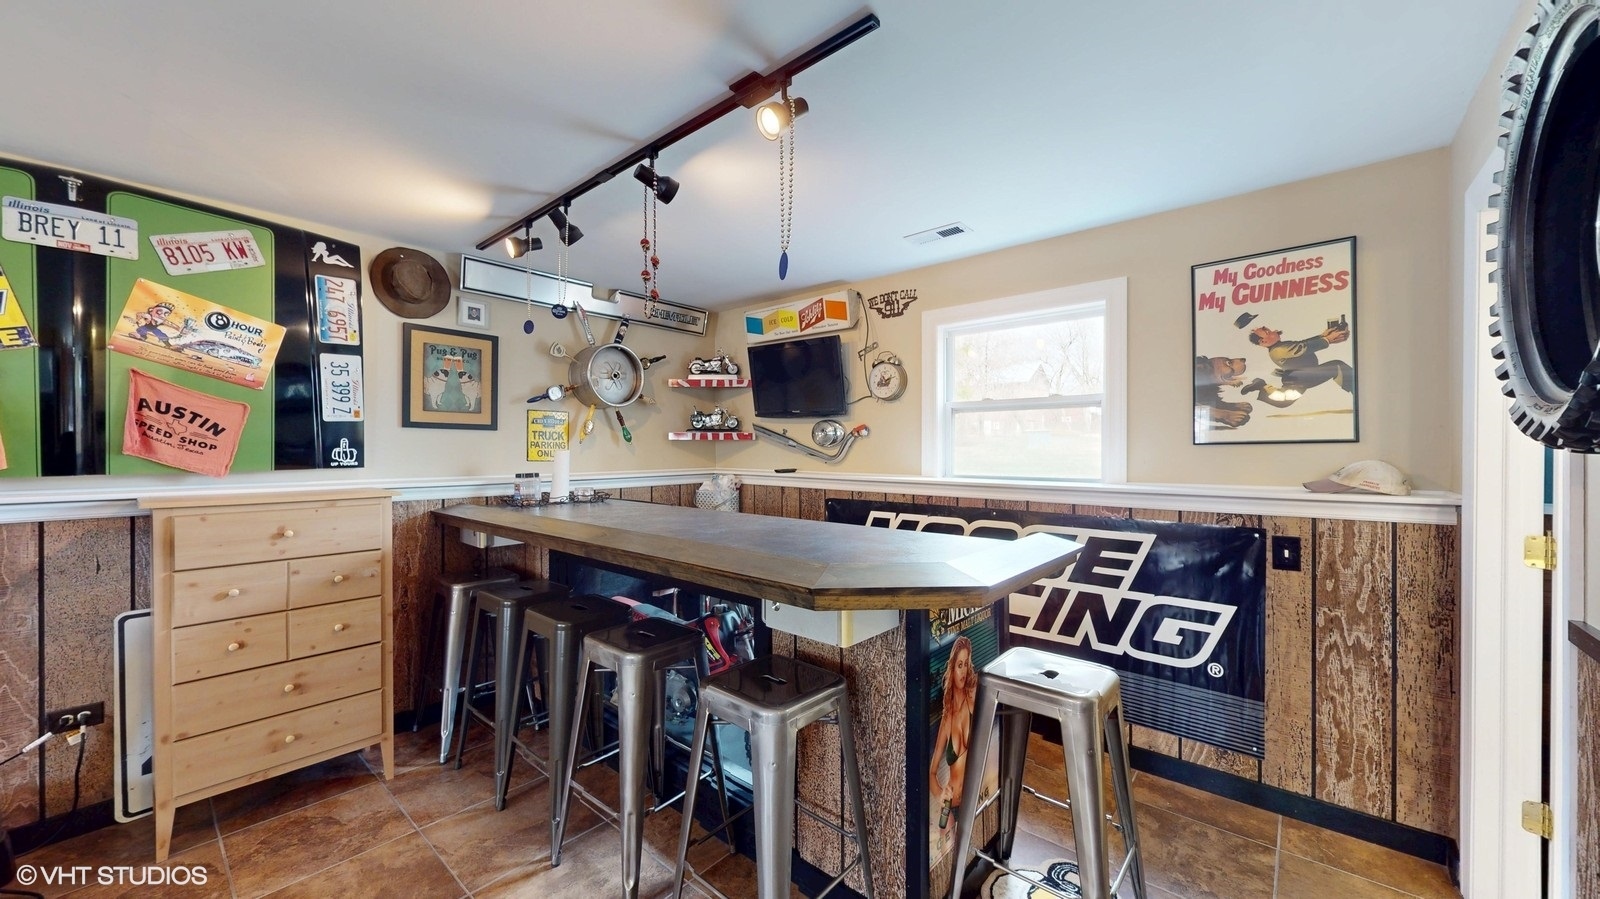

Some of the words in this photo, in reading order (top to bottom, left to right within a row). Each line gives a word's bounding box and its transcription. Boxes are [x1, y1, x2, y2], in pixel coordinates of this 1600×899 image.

[18, 211, 80, 240] BREY
[98, 226, 125, 248] 11
[162, 243, 215, 266] 8105
[222, 240, 249, 260] KW
[1212, 267, 1238, 287] My
[1243, 256, 1324, 281] Goodness
[325, 278, 345, 304] 247
[900, 289, 918, 300] CALL
[1198, 292, 1226, 312] My
[1231, 270, 1350, 306] GUINNESS
[230, 322, 263, 336] HOUR
[327, 310, 348, 342] 6957
[780, 316, 794, 324] COLD
[429, 344, 448, 356] Pug
[460, 348, 478, 360] Pug
[330, 361, 350, 377] 35
[332, 380, 351, 404] 399
[137, 398, 226, 438] AUSTIN
[134, 418, 173, 438] SPEED
[179, 436, 218, 450] SHOP
[530, 441, 566, 450] PARKING
[532, 430, 565, 440] TRUCK
[537, 450, 555, 458] ONL
